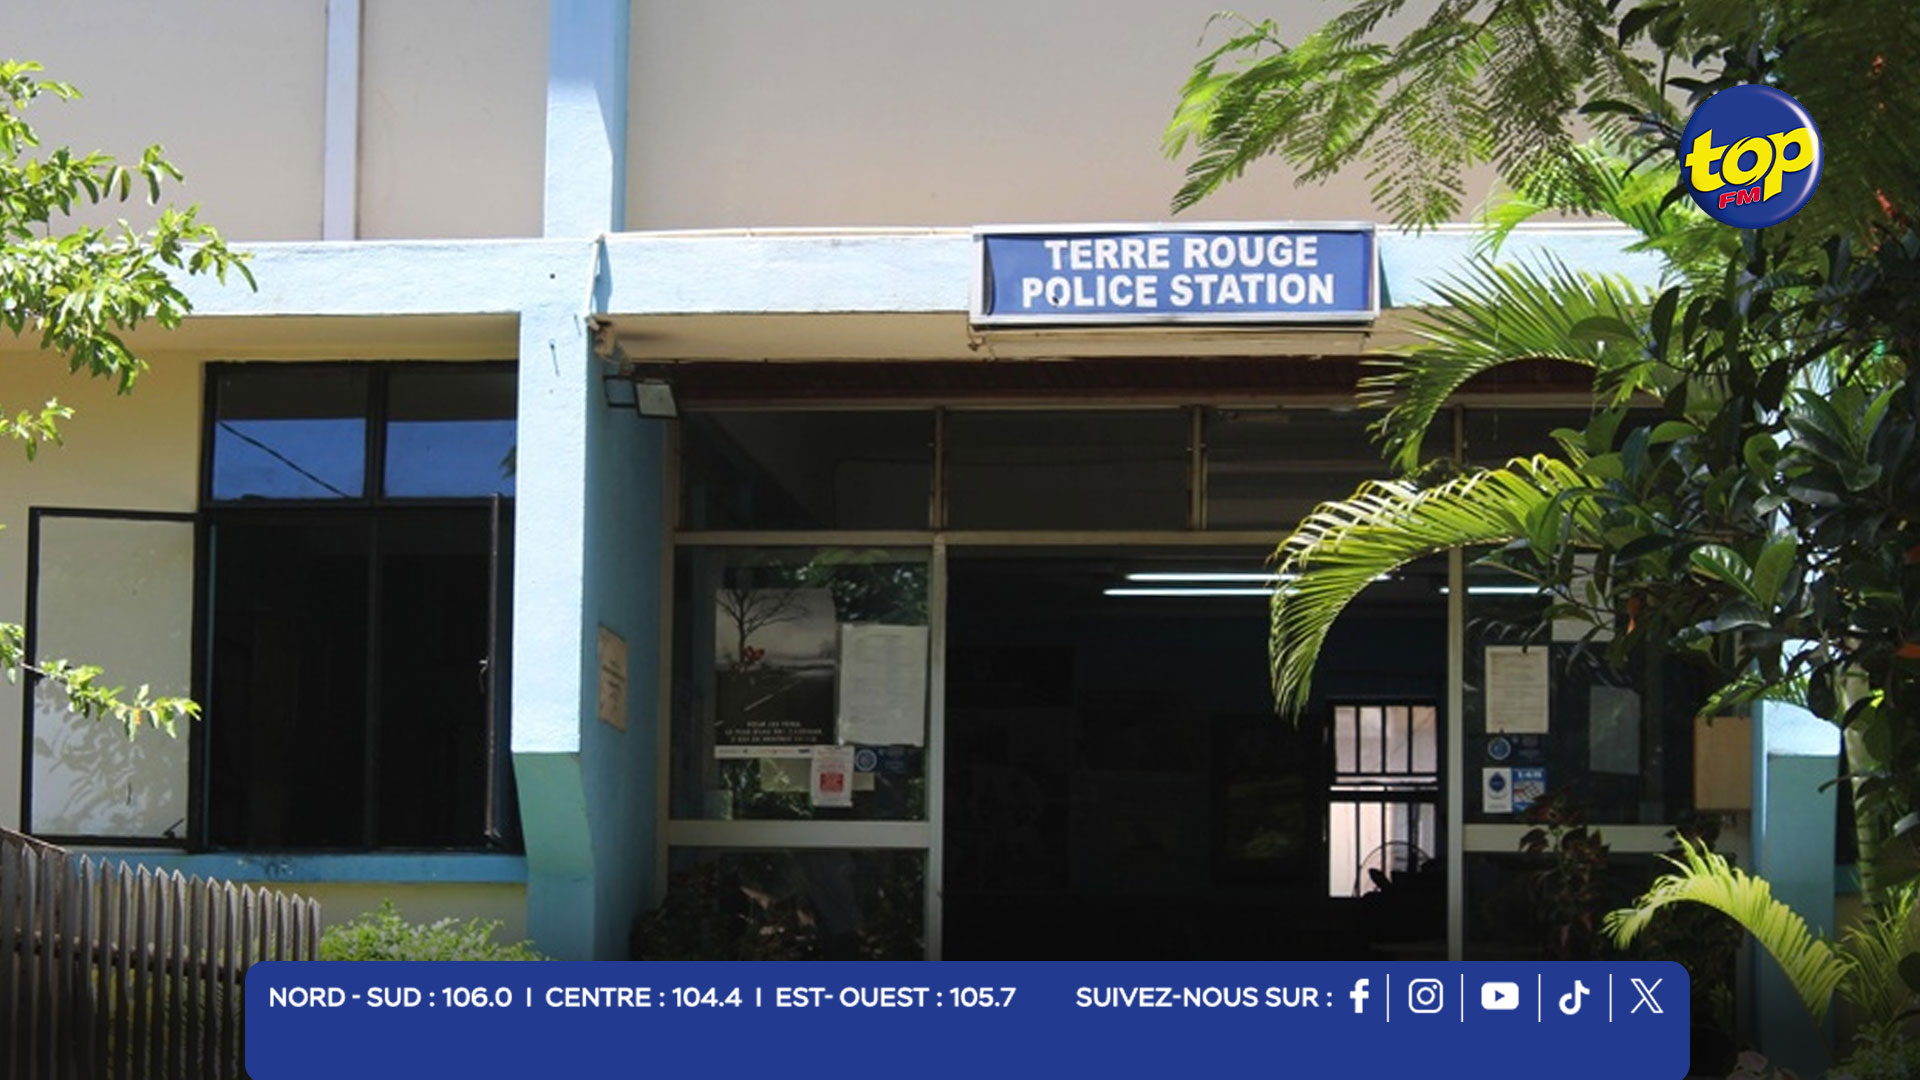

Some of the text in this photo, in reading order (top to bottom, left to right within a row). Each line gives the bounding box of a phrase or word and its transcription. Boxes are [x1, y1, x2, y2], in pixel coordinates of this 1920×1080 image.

[1044, 236, 1319, 270] TERRE ROUGE
[1022, 273, 1335, 308] POLICE STATION
